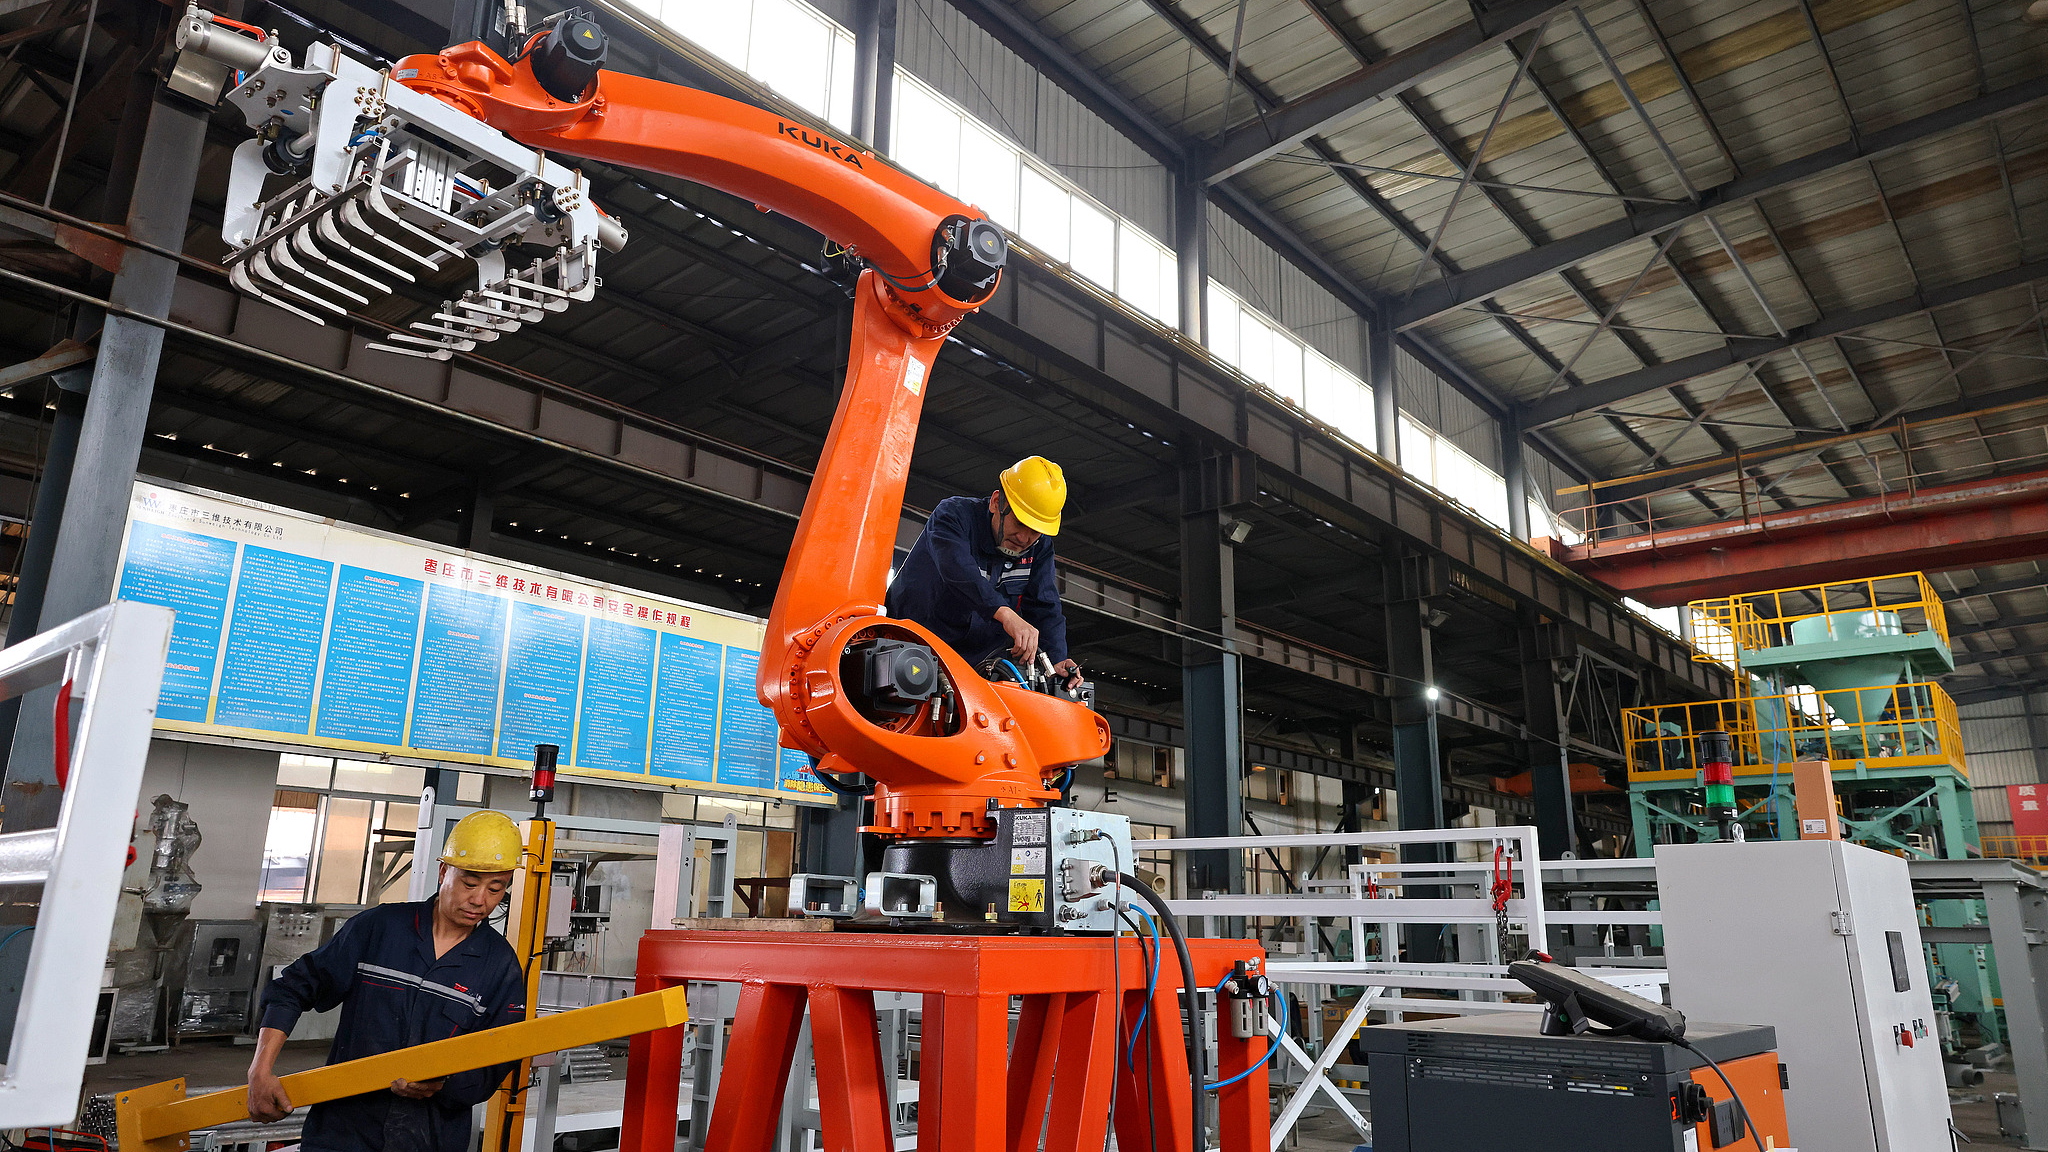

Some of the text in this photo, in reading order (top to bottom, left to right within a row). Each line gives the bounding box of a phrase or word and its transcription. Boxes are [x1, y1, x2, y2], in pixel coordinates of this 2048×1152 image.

[778, 121, 863, 170] KUKA
[168, 504, 284, 535] 枣庄市三维技术有限公司
[424, 558, 692, 629] 枣庄市三维技术有限公司安全操作规程
[2018, 785, 2040, 811] 质量
